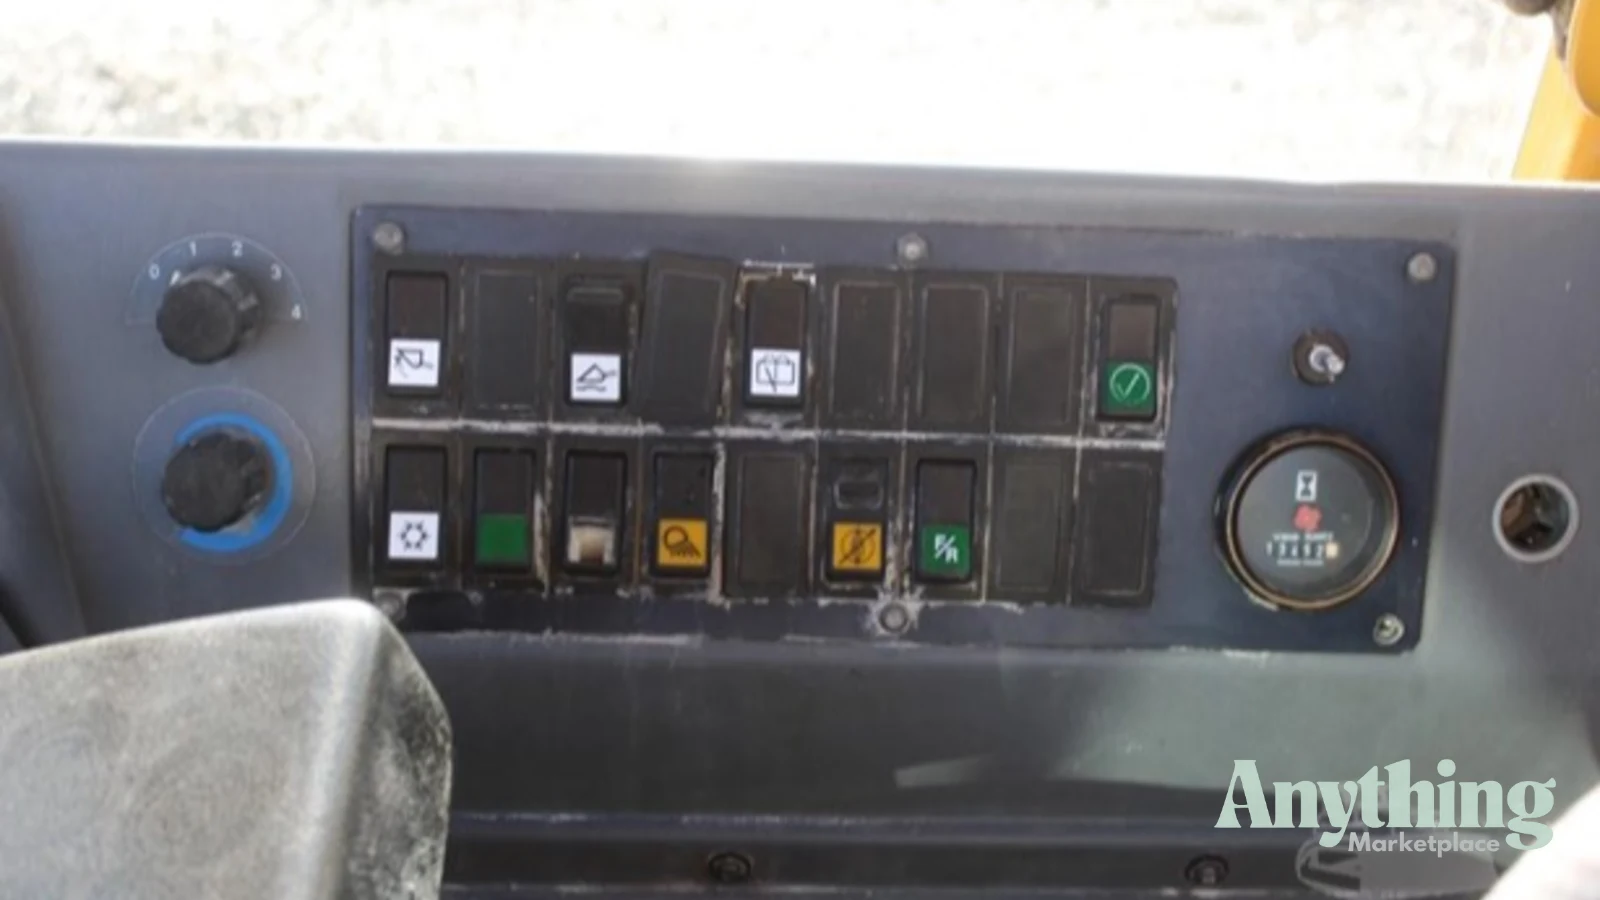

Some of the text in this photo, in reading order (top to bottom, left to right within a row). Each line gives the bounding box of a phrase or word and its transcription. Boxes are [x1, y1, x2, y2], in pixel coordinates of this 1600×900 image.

[149, 240, 301, 320] 0 1 2 3 4
